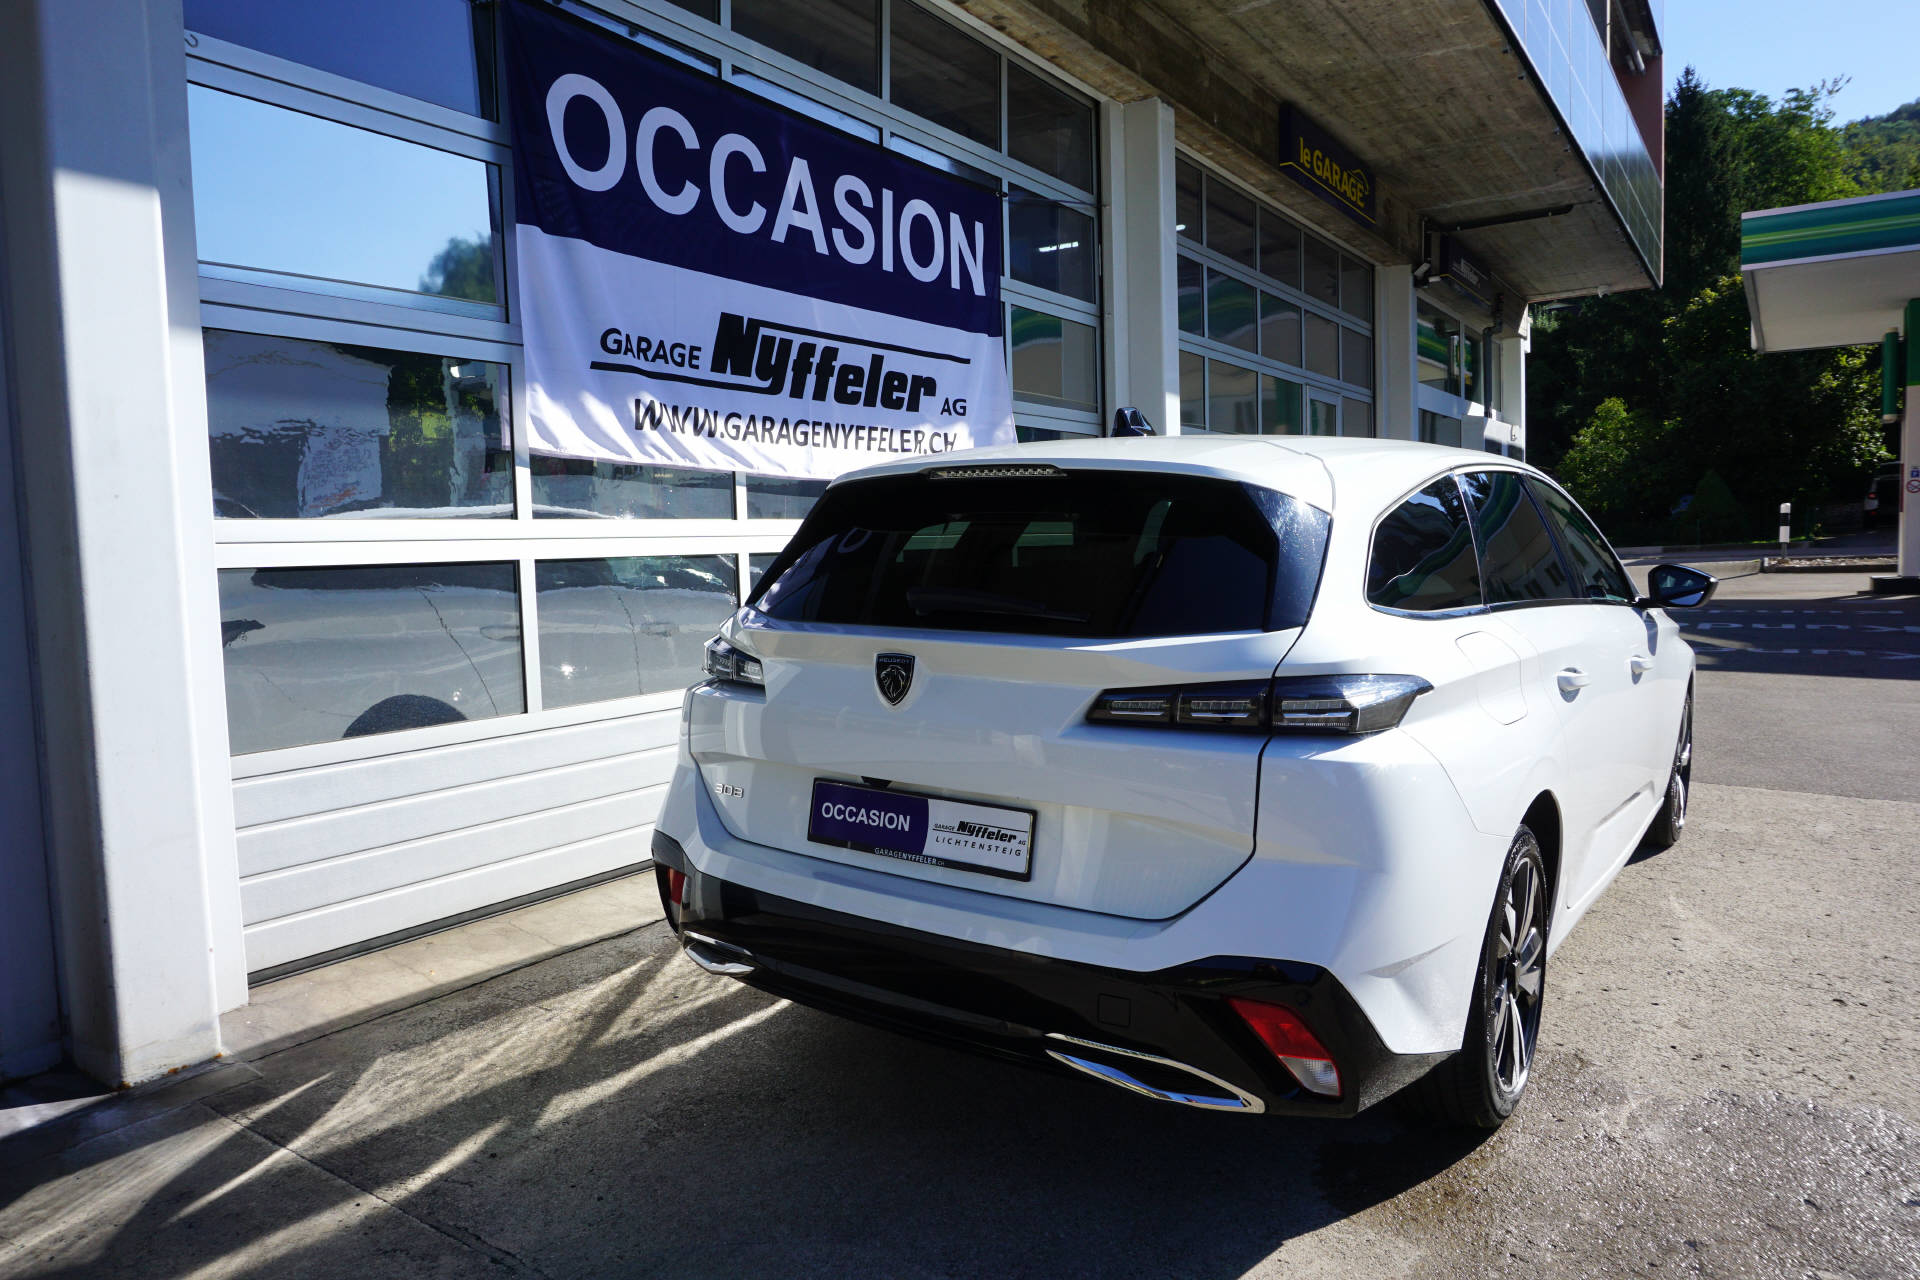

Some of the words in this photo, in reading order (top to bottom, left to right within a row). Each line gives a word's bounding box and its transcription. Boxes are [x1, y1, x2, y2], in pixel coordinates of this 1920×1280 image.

[546, 73, 987, 297] OCCASION
[1299, 136, 1311, 169] le
[1313, 149, 1365, 208] GARAGE
[600, 327, 702, 370] GARAGE
[710, 312, 937, 413] Nyffeler
[940, 397, 967, 417] AG
[634, 398, 957, 455] WWW.GARAGENYFFELER.CH
[821, 802, 911, 832] OCCASION
[934, 823, 956, 832] GARAGE
[957, 821, 1017, 843] Nyffeler
[935, 835, 1022, 857] LICHTENSTEIG
